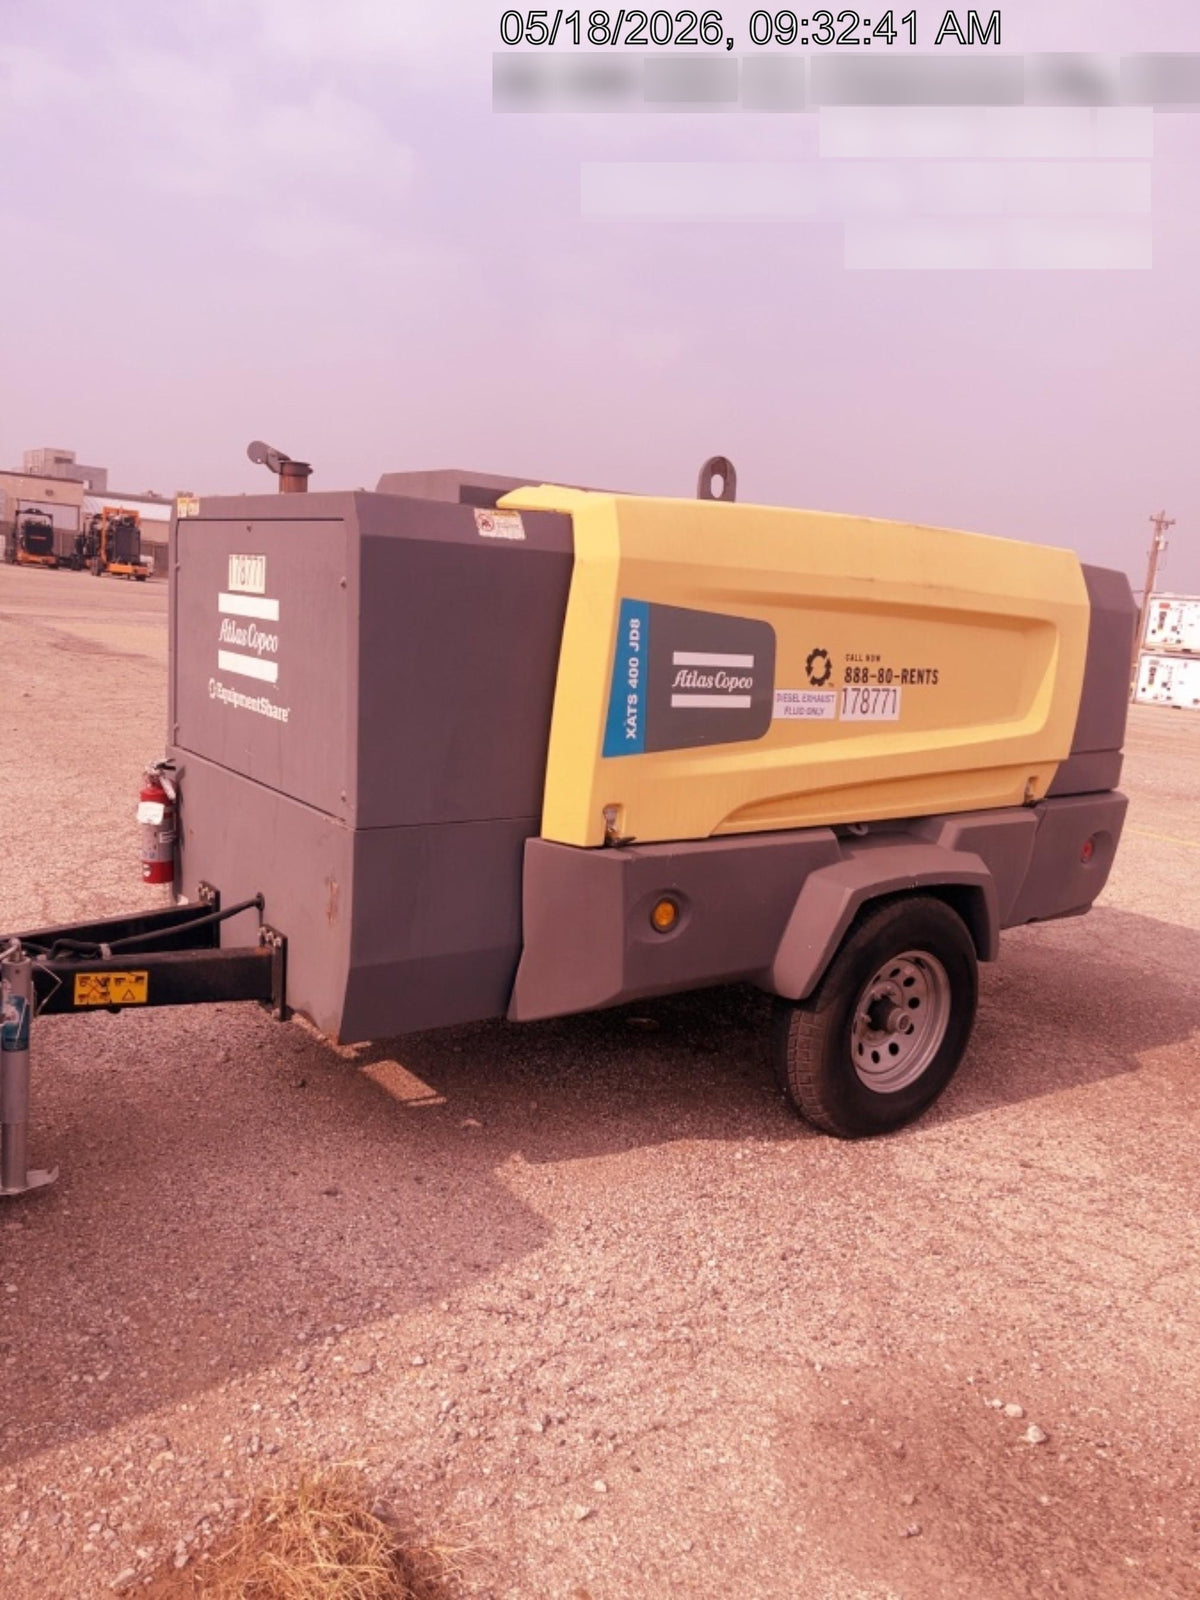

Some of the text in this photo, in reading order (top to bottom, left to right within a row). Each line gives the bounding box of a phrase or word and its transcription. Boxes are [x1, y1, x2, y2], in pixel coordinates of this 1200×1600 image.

[626, 618, 641, 740] XATS 400 JD8
[671, 669, 753, 693] Atlas Copco
[844, 666, 940, 686] 888-80-RENTS
[841, 687, 897, 715] 178771
